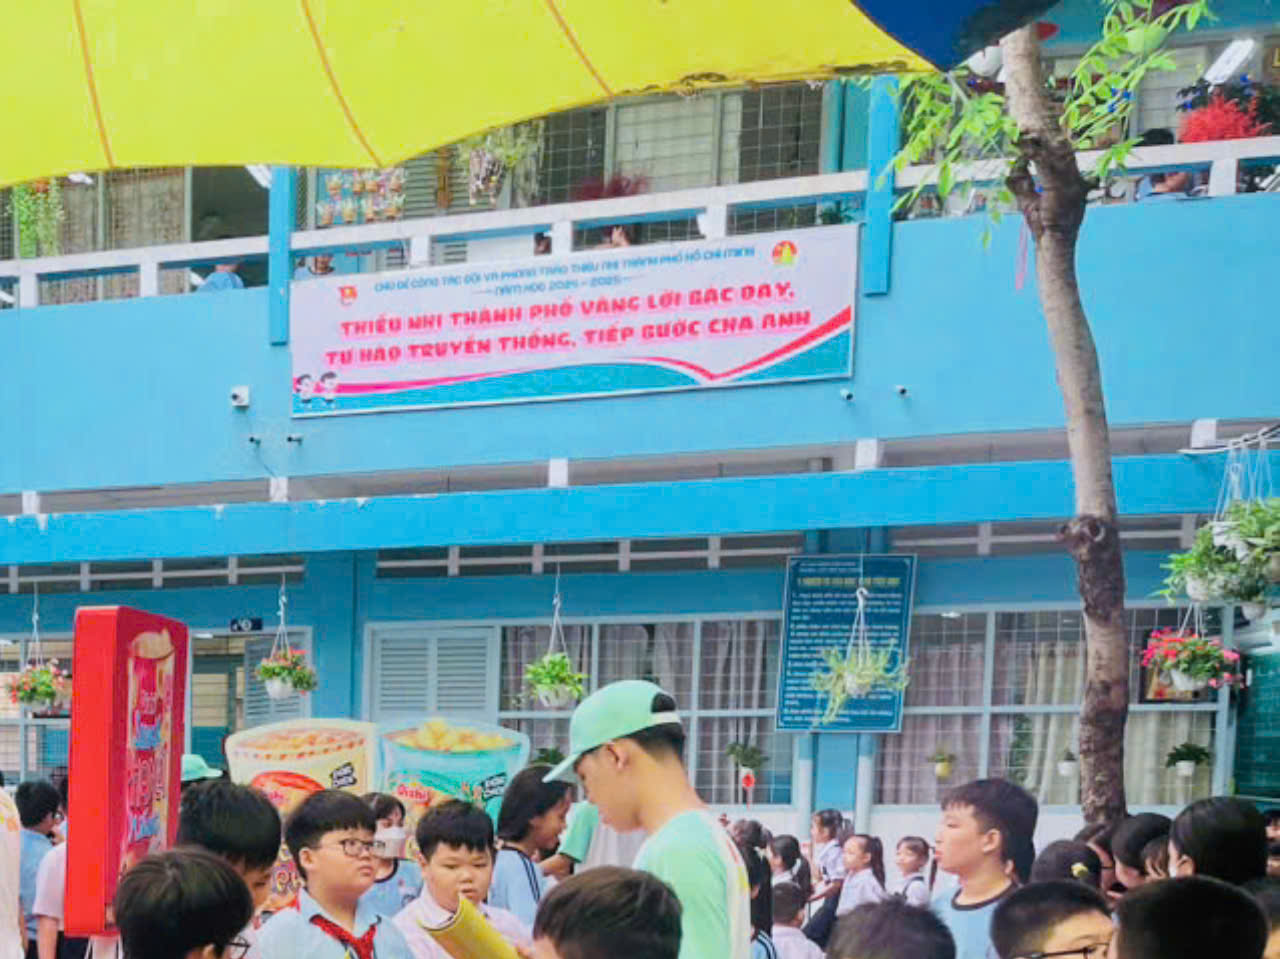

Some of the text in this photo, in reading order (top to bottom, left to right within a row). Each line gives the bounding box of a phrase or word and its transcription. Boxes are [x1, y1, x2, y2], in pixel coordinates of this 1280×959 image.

[340, 312, 402, 337] THIẾU
[408, 313, 442, 331] NHI
[450, 304, 522, 327] THÀNH
[529, 296, 574, 319] PHỐ
[580, 293, 640, 315] VÂNG
[647, 288, 682, 310] LỜI
[407, 334, 491, 358] TRUYỀN
[584, 320, 635, 344] TIẾP
[641, 317, 702, 340] BƯỚC
[709, 315, 754, 334] CHA
[762, 308, 812, 331] ANH
